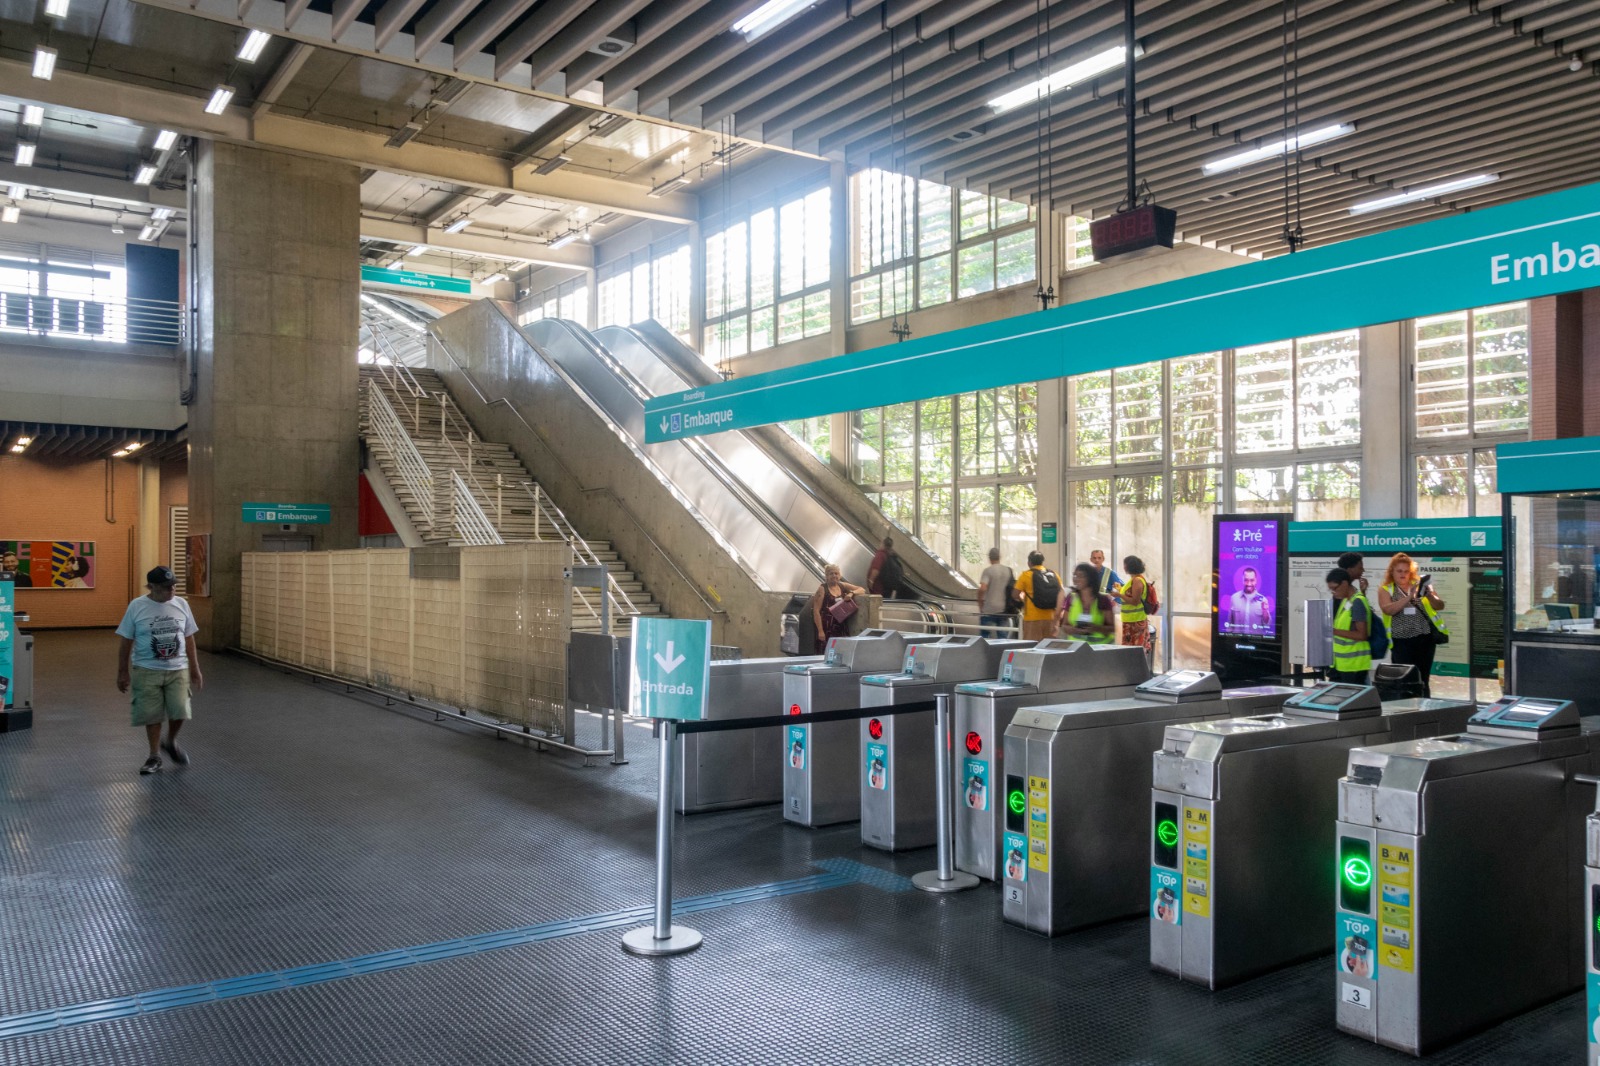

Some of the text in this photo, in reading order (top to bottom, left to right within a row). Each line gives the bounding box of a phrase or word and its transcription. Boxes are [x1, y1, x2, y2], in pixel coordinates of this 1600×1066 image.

[1491, 241, 1600, 285] Emba
[400, 277, 428, 287] Embarque
[683, 391, 705, 401] Boarding
[684, 409, 733, 428] Embarque
[278, 513, 318, 521] Embarque
[1242, 528, 1263, 542] Pré
[1363, 534, 1437, 548] Informações
[642, 680, 693, 695] Entrada
[870, 747, 884, 757] TOP
[968, 763, 984, 775] TOP
[1008, 837, 1024, 849] TOP
[1157, 873, 1177, 887] TOP
[1012, 890, 1017, 900] 5
[1343, 919, 1370, 935] TOP
[1354, 942, 1366, 951] TOP
[1353, 989, 1360, 1002] 3
